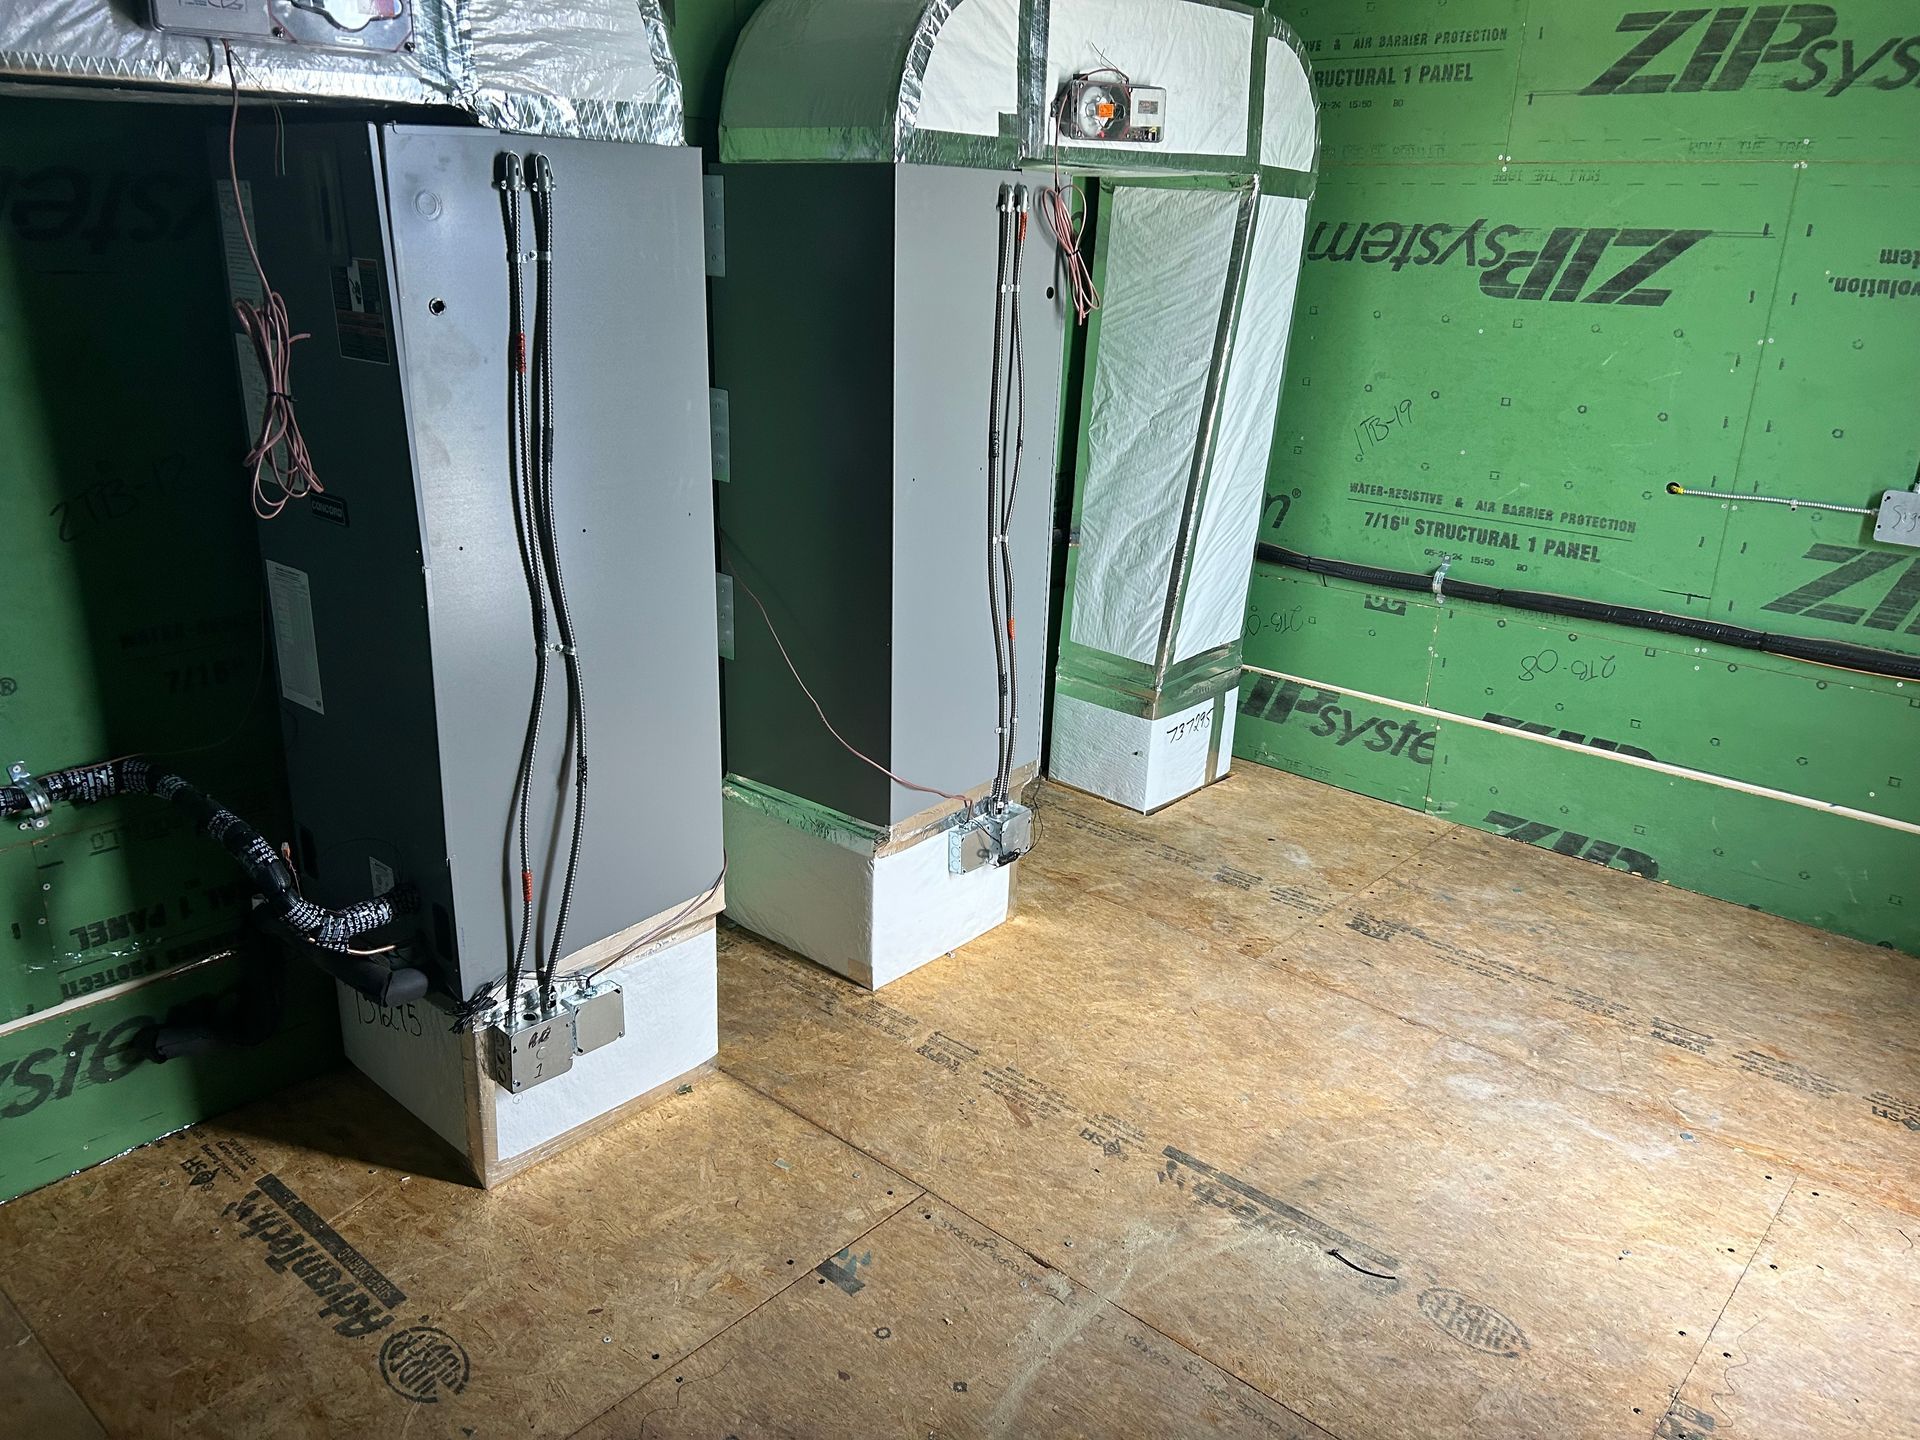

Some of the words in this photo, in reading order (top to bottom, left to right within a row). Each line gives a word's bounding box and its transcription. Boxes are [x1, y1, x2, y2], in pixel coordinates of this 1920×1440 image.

[1353, 35, 1373, 49] AIR
[1379, 31, 1428, 48] BARRIER
[1434, 27, 1507, 45] PROTECTION
[1404, 67, 1412, 83] 1
[1418, 62, 1474, 83] PANEL
[1349, 482, 1444, 506] WATER-RESISTIVE
[1454, 497, 1464, 508] &
[1475, 500, 1495, 513] AIR
[1502, 503, 1554, 521] BARRIER
[1560, 512, 1637, 534] PROTECTION
[1364, 511, 1410, 532] 7/16"
[1414, 519, 1521, 550] STRUCTURAL
[1528, 536, 1537, 553] 1
[1544, 539, 1601, 563] PANEL
[1470, 556, 1495, 567] 15:50
[533, 1062, 543, 1079] 1
